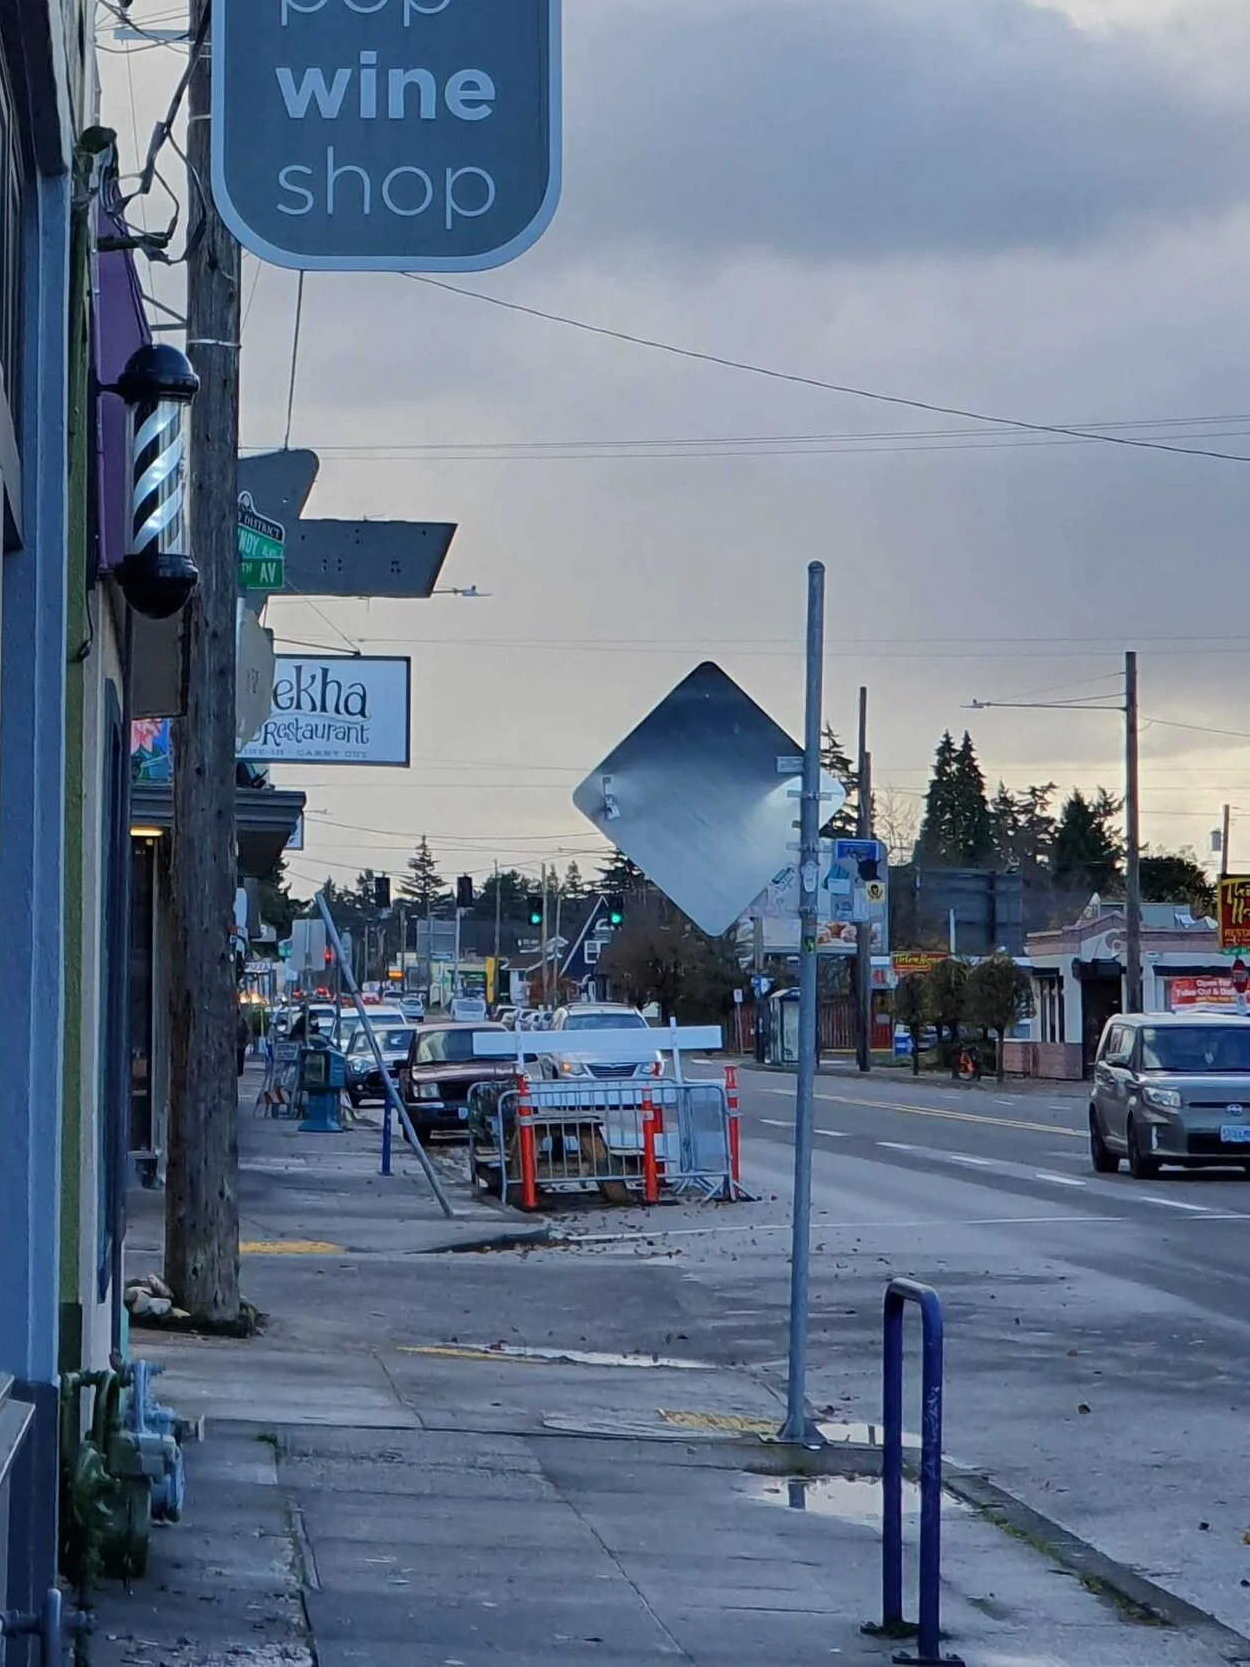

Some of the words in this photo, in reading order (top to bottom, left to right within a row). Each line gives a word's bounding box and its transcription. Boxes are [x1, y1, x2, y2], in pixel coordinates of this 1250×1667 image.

[276, 51, 496, 121] wine
[276, 146, 496, 230] shop
[238, 528, 260, 556] NDY
[244, 515, 280, 539] DISTRICT
[259, 562, 277, 583] AV
[272, 665, 368, 719] ekha
[261, 717, 371, 747] Restaurant
